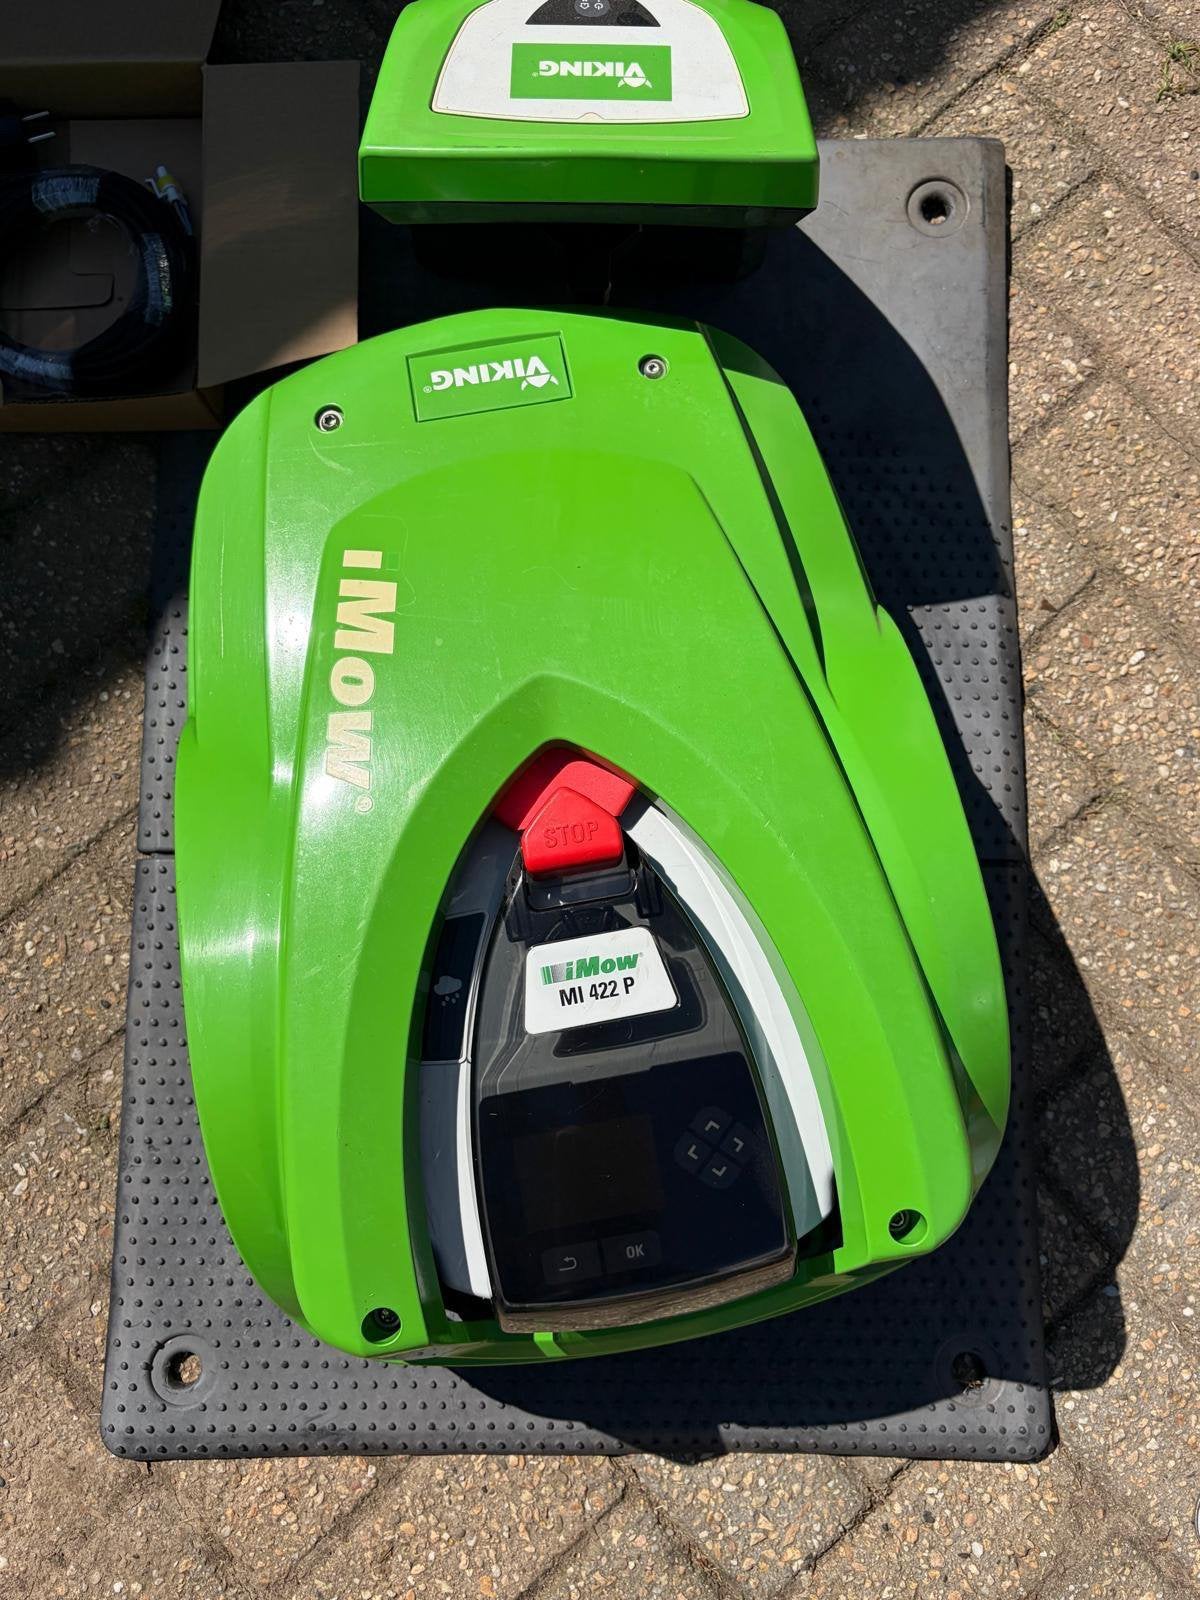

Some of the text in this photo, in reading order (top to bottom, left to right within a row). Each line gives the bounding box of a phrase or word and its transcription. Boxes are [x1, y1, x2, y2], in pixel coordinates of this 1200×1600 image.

[543, 820, 599, 849] STOP
[559, 976, 635, 1006] MI 422 P
[625, 1243, 645, 1259] OK
